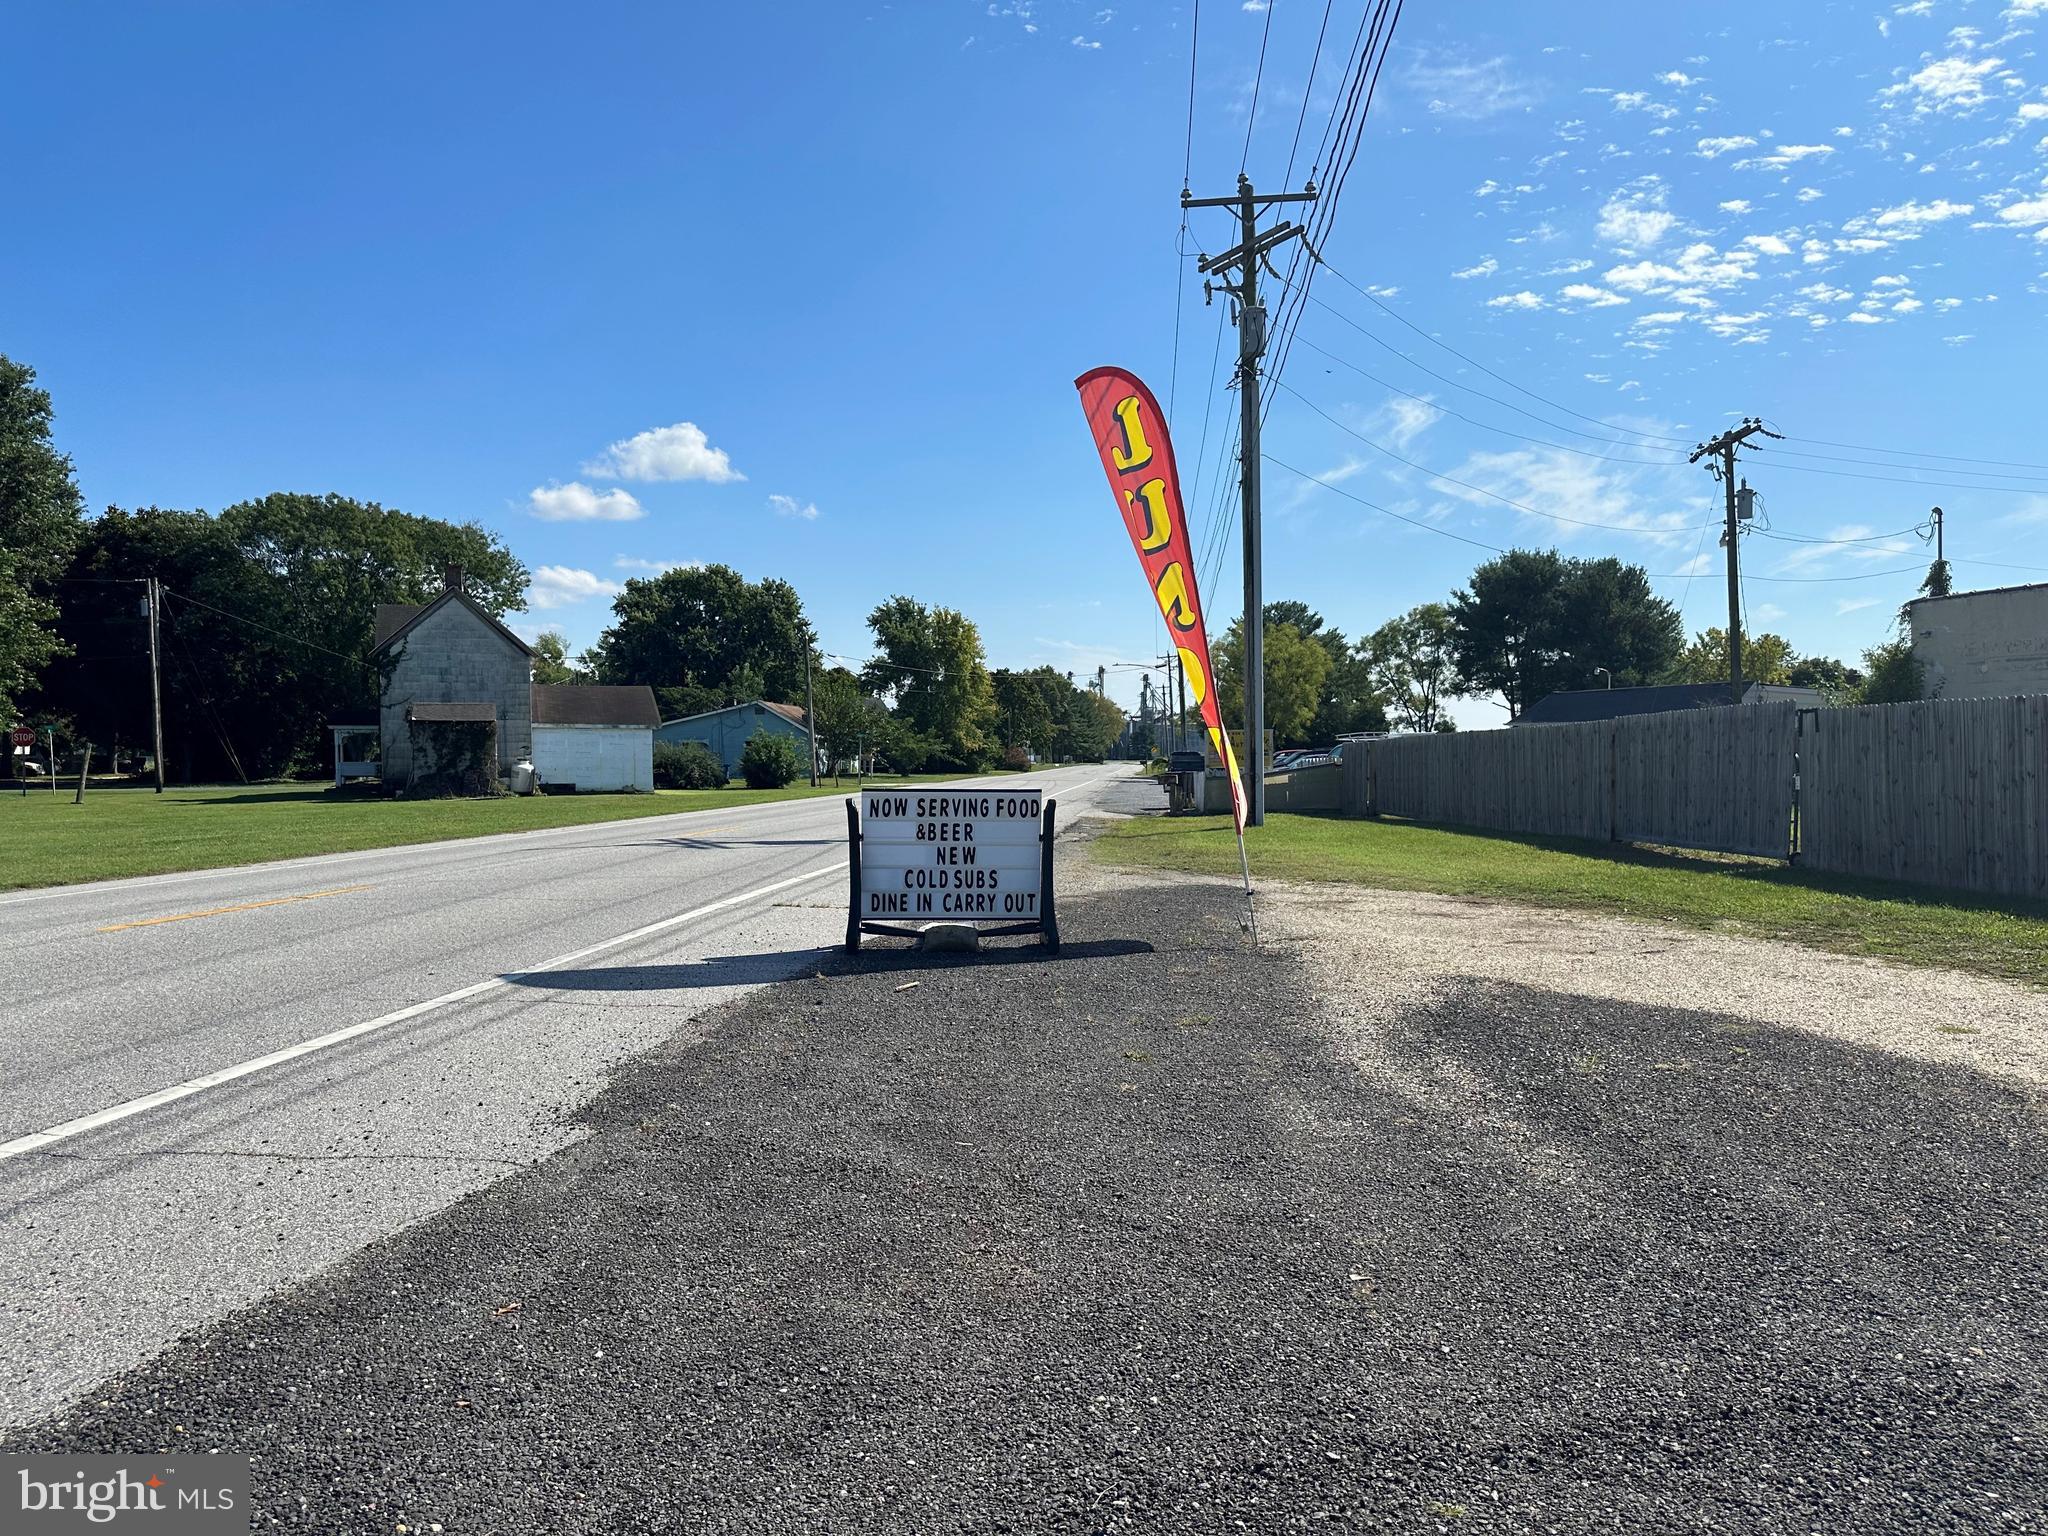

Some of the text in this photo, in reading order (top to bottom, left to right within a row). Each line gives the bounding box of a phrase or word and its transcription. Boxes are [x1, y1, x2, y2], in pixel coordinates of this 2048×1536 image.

[14, 733, 34, 741] STOP
[869, 798, 1040, 818] NOW SERVING FOOD
[936, 846, 976, 865] NEW
[904, 869, 998, 889] COLD SUBS
[871, 893, 1036, 912] DINE IN CARRY OUT
